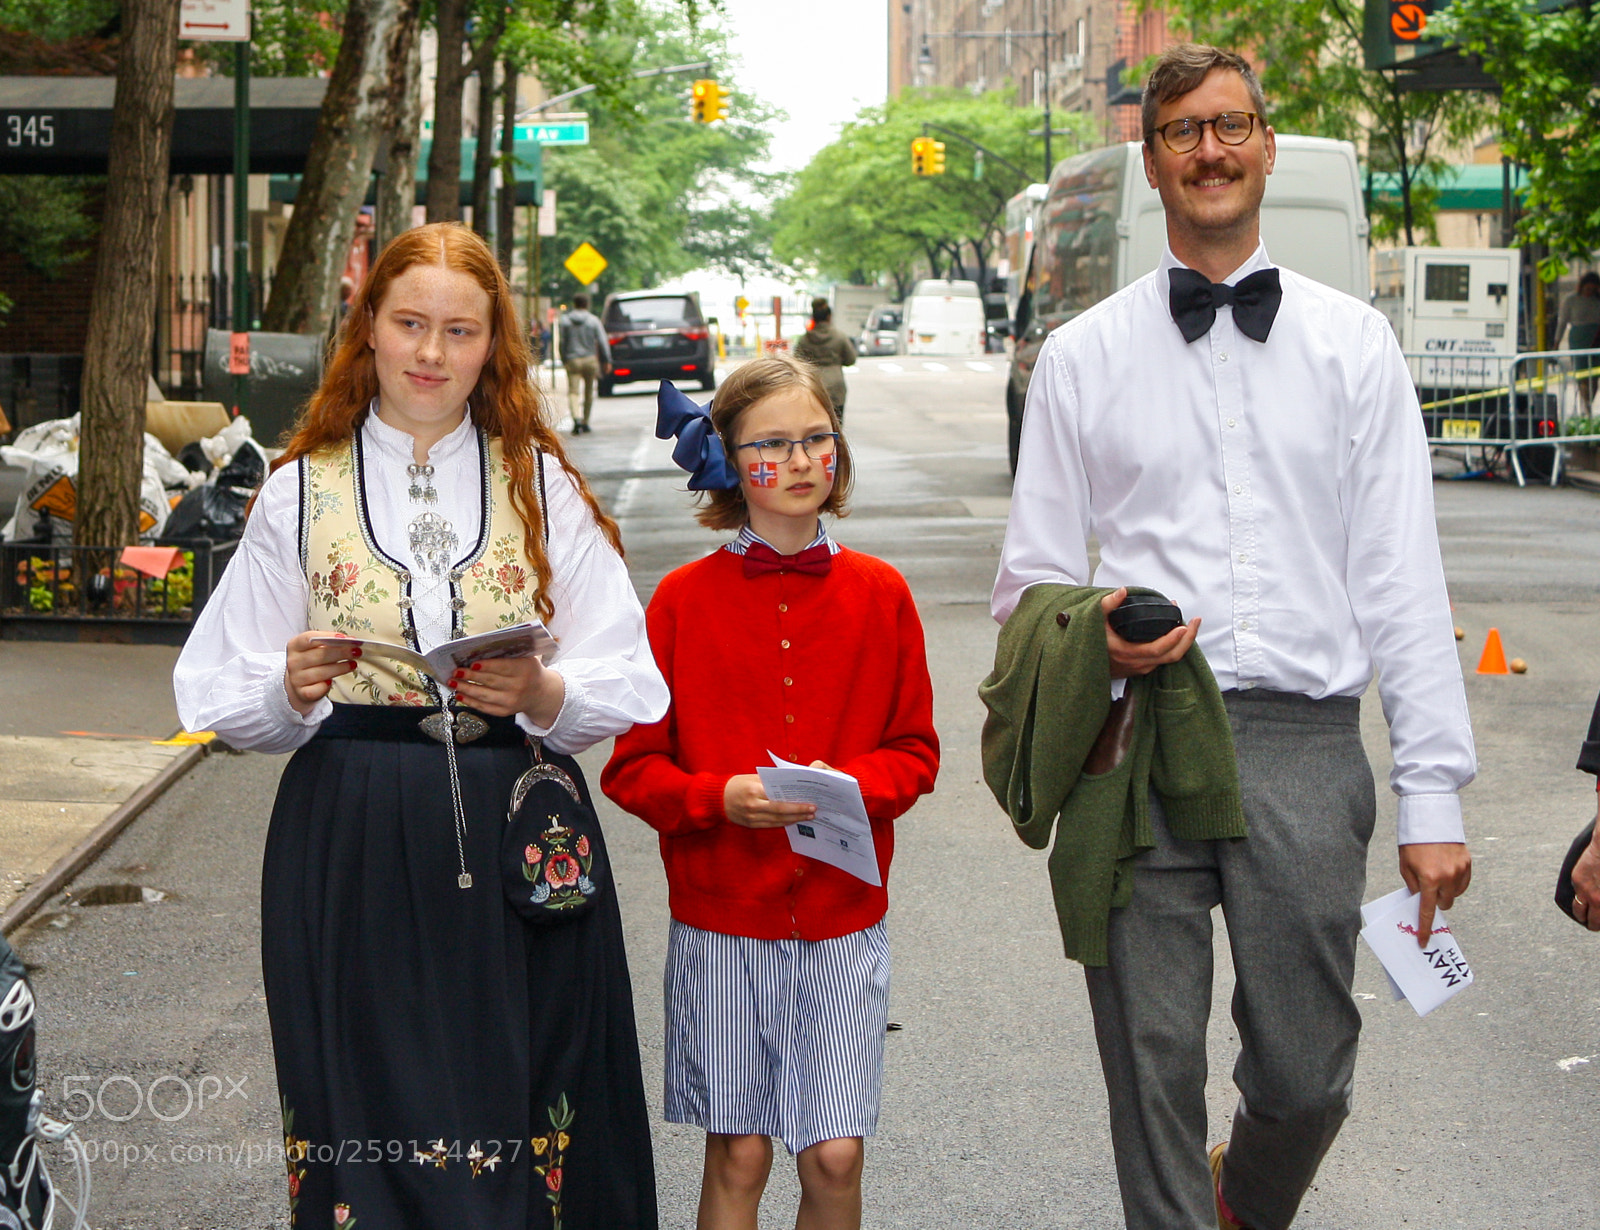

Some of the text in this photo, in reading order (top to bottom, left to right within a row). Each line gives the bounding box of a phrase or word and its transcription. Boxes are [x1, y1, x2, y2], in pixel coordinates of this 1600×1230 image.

[7, 115, 54, 147] 345
[1425, 339, 1458, 352] CMT
[1423, 948, 1461, 988] MAY
[1446, 947, 1470, 978] 17TH
